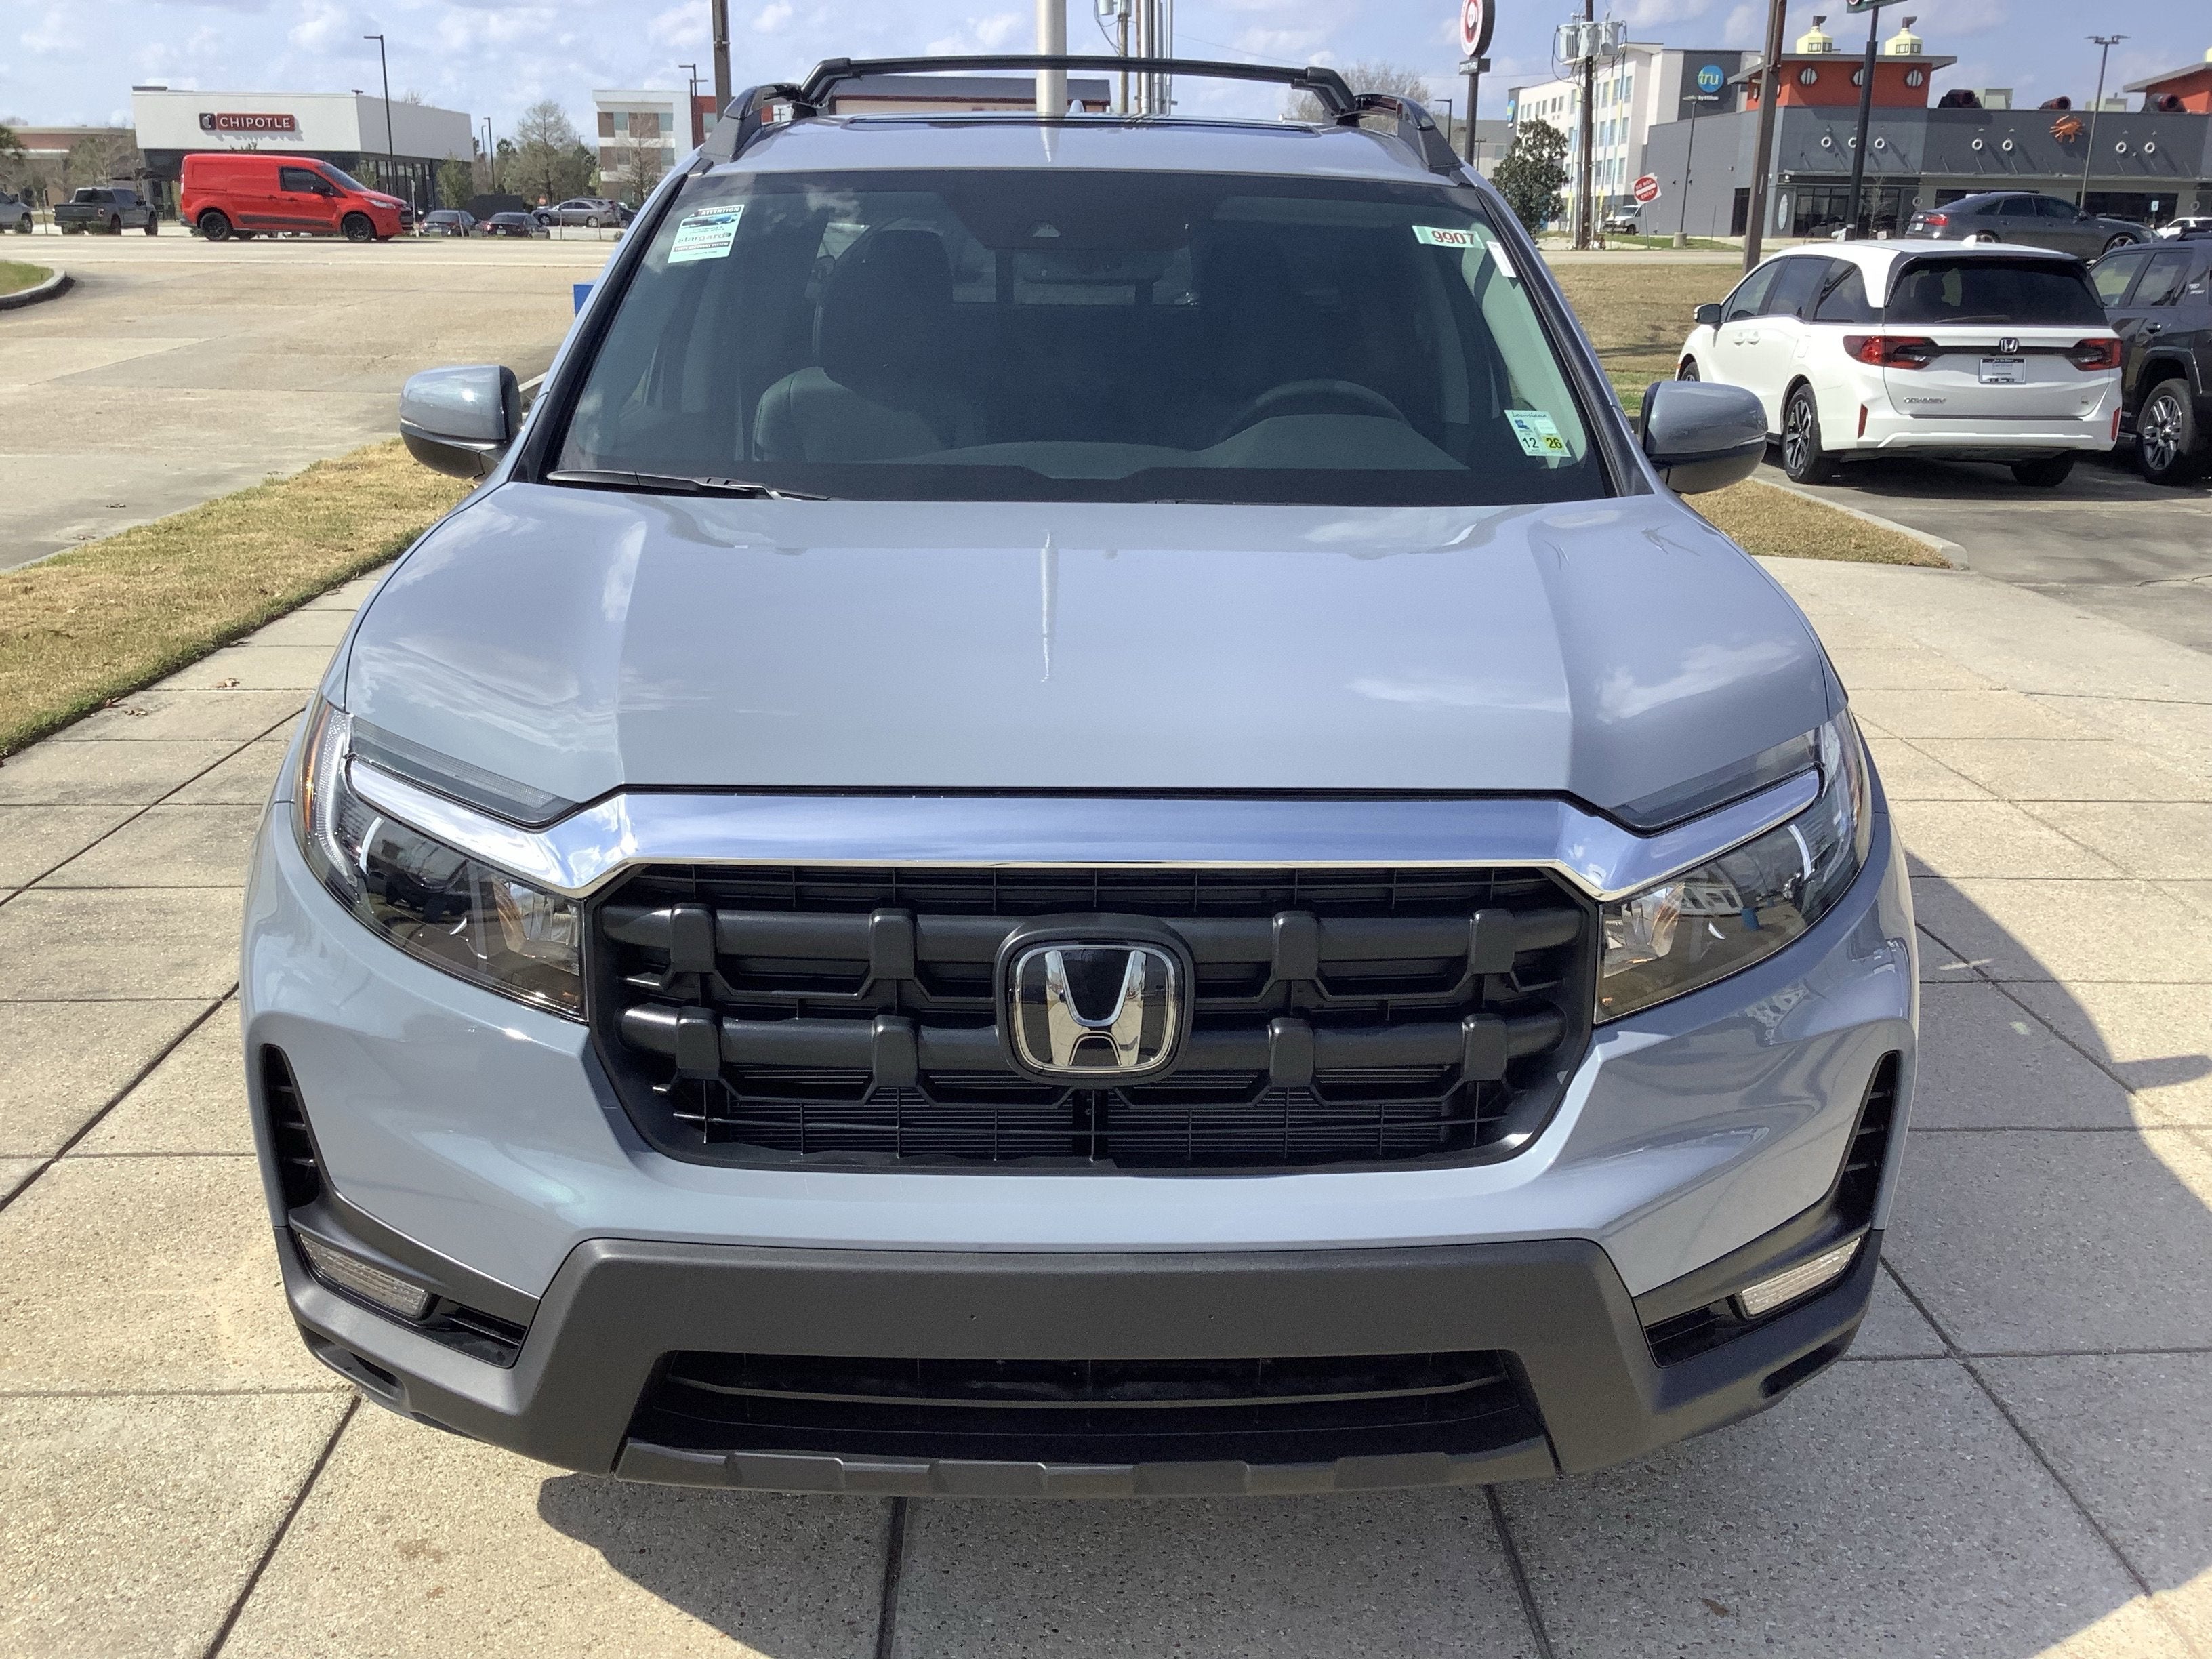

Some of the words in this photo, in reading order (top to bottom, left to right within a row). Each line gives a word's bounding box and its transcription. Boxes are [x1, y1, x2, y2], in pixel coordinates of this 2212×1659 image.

[1698, 70, 1719, 85] tru
[219, 117, 291, 129] CHIPOTLE
[701, 207, 740, 216] ATTENTION
[1431, 230, 1475, 245] 9907
[1523, 437, 1540, 448] 12
[1545, 438, 1563, 449] 26
